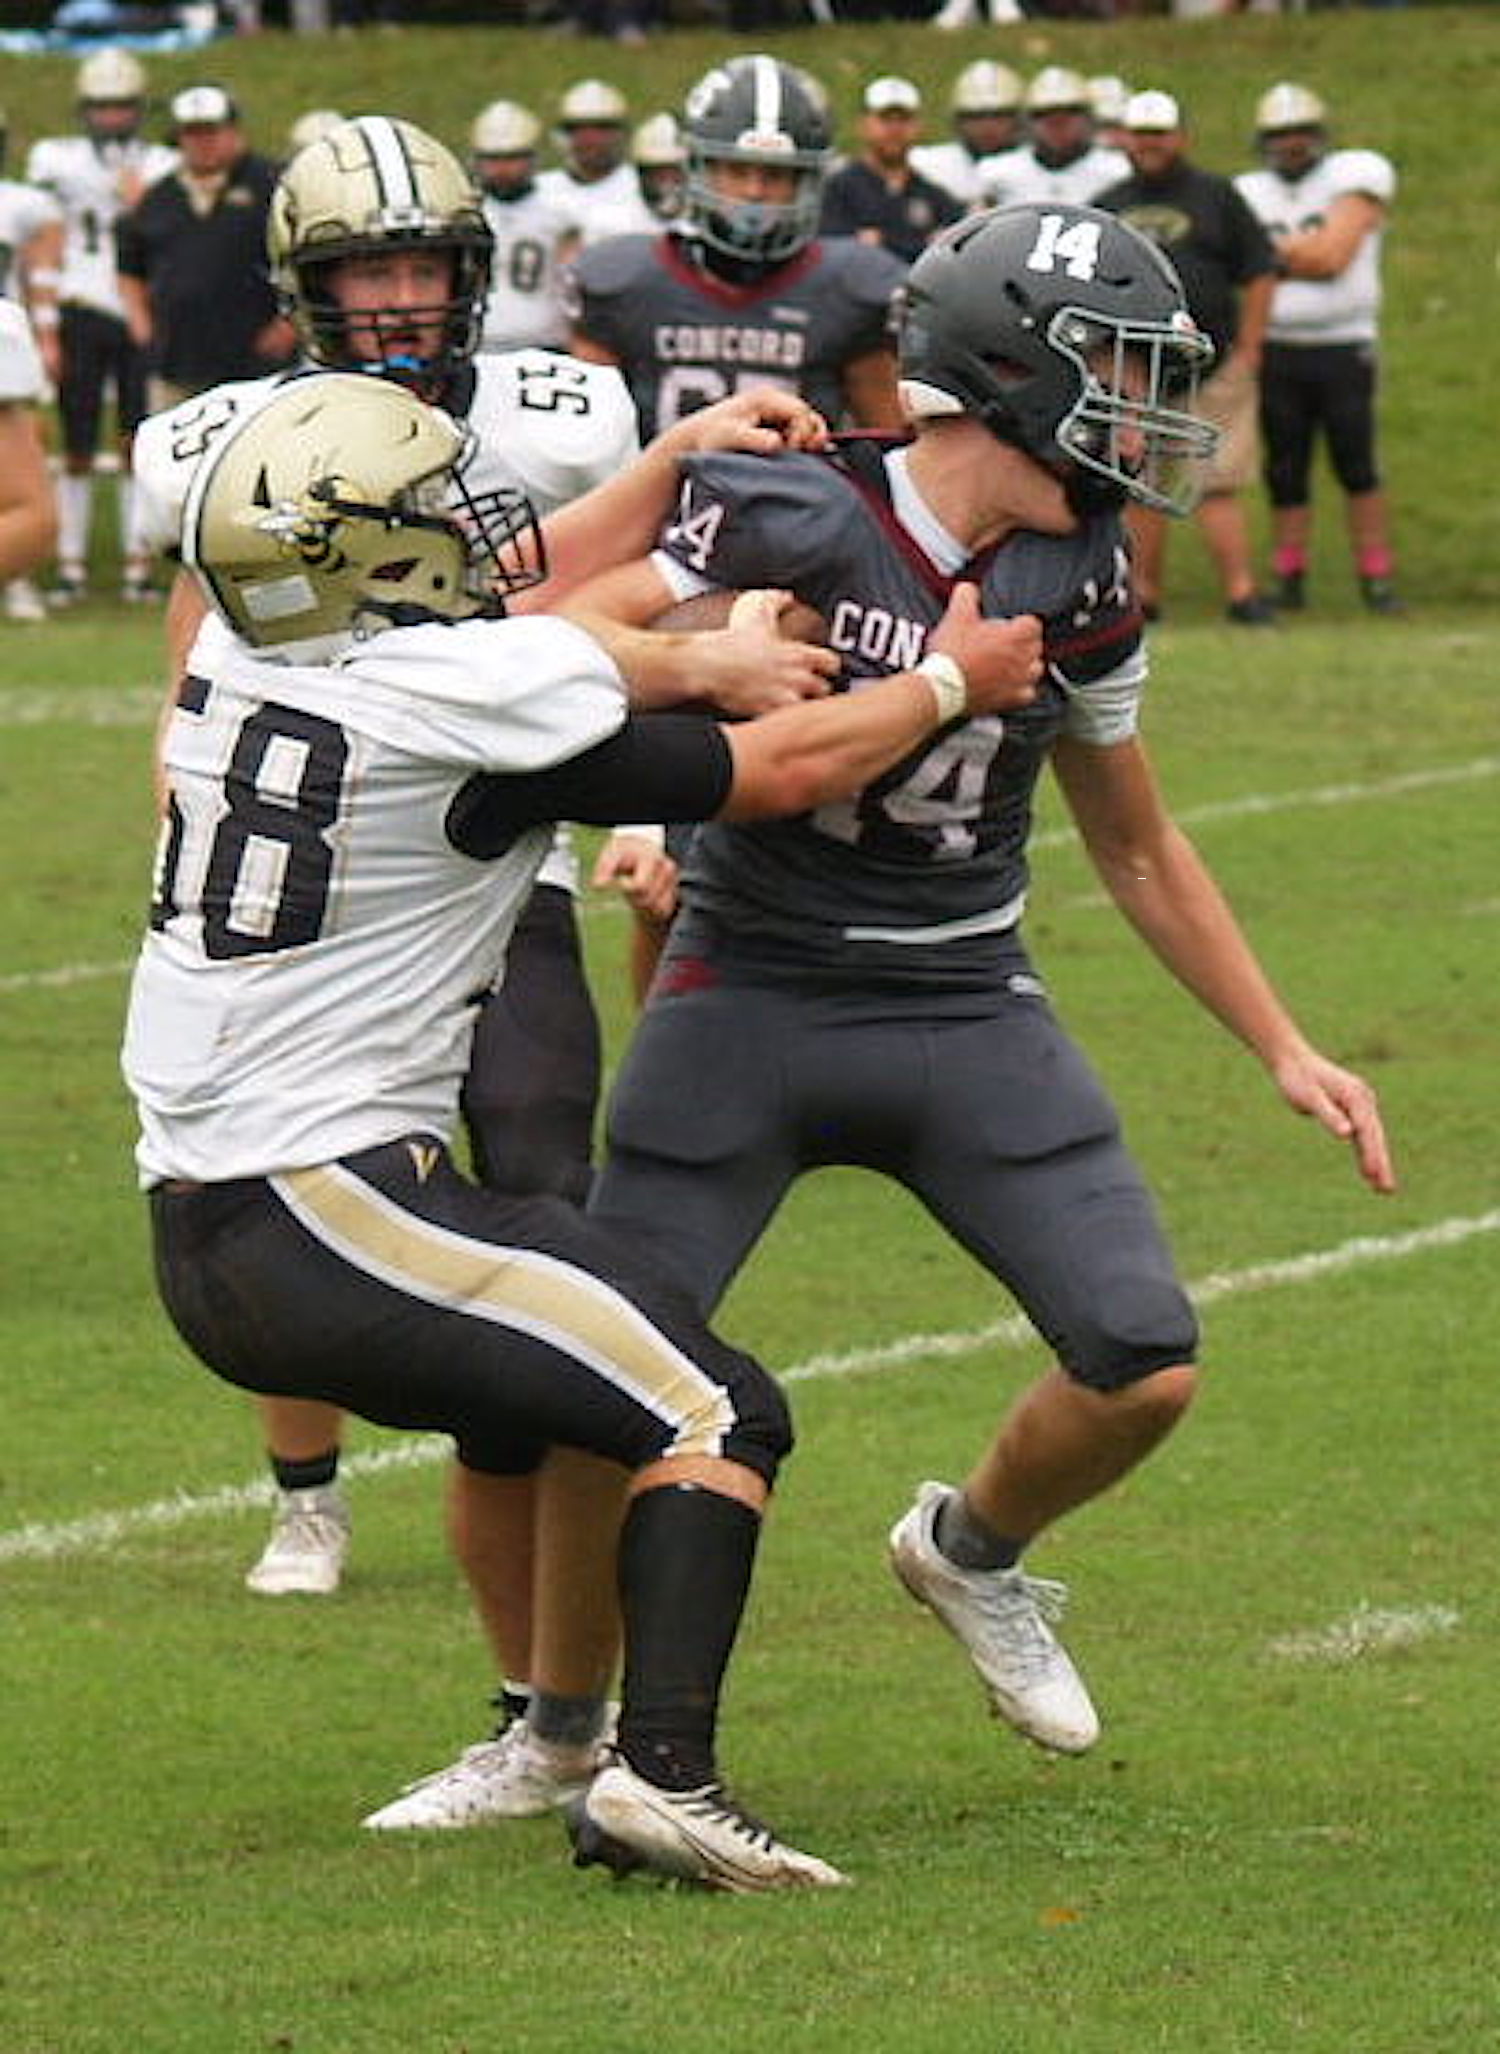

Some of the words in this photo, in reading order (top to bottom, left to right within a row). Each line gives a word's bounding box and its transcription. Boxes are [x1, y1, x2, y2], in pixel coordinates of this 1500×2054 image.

[1025, 213, 1101, 283] 14
[655, 325, 803, 367] CONCORD
[519, 364, 589, 415] 55
[830, 600, 926, 671] CON
[812, 714, 1003, 861] 4
